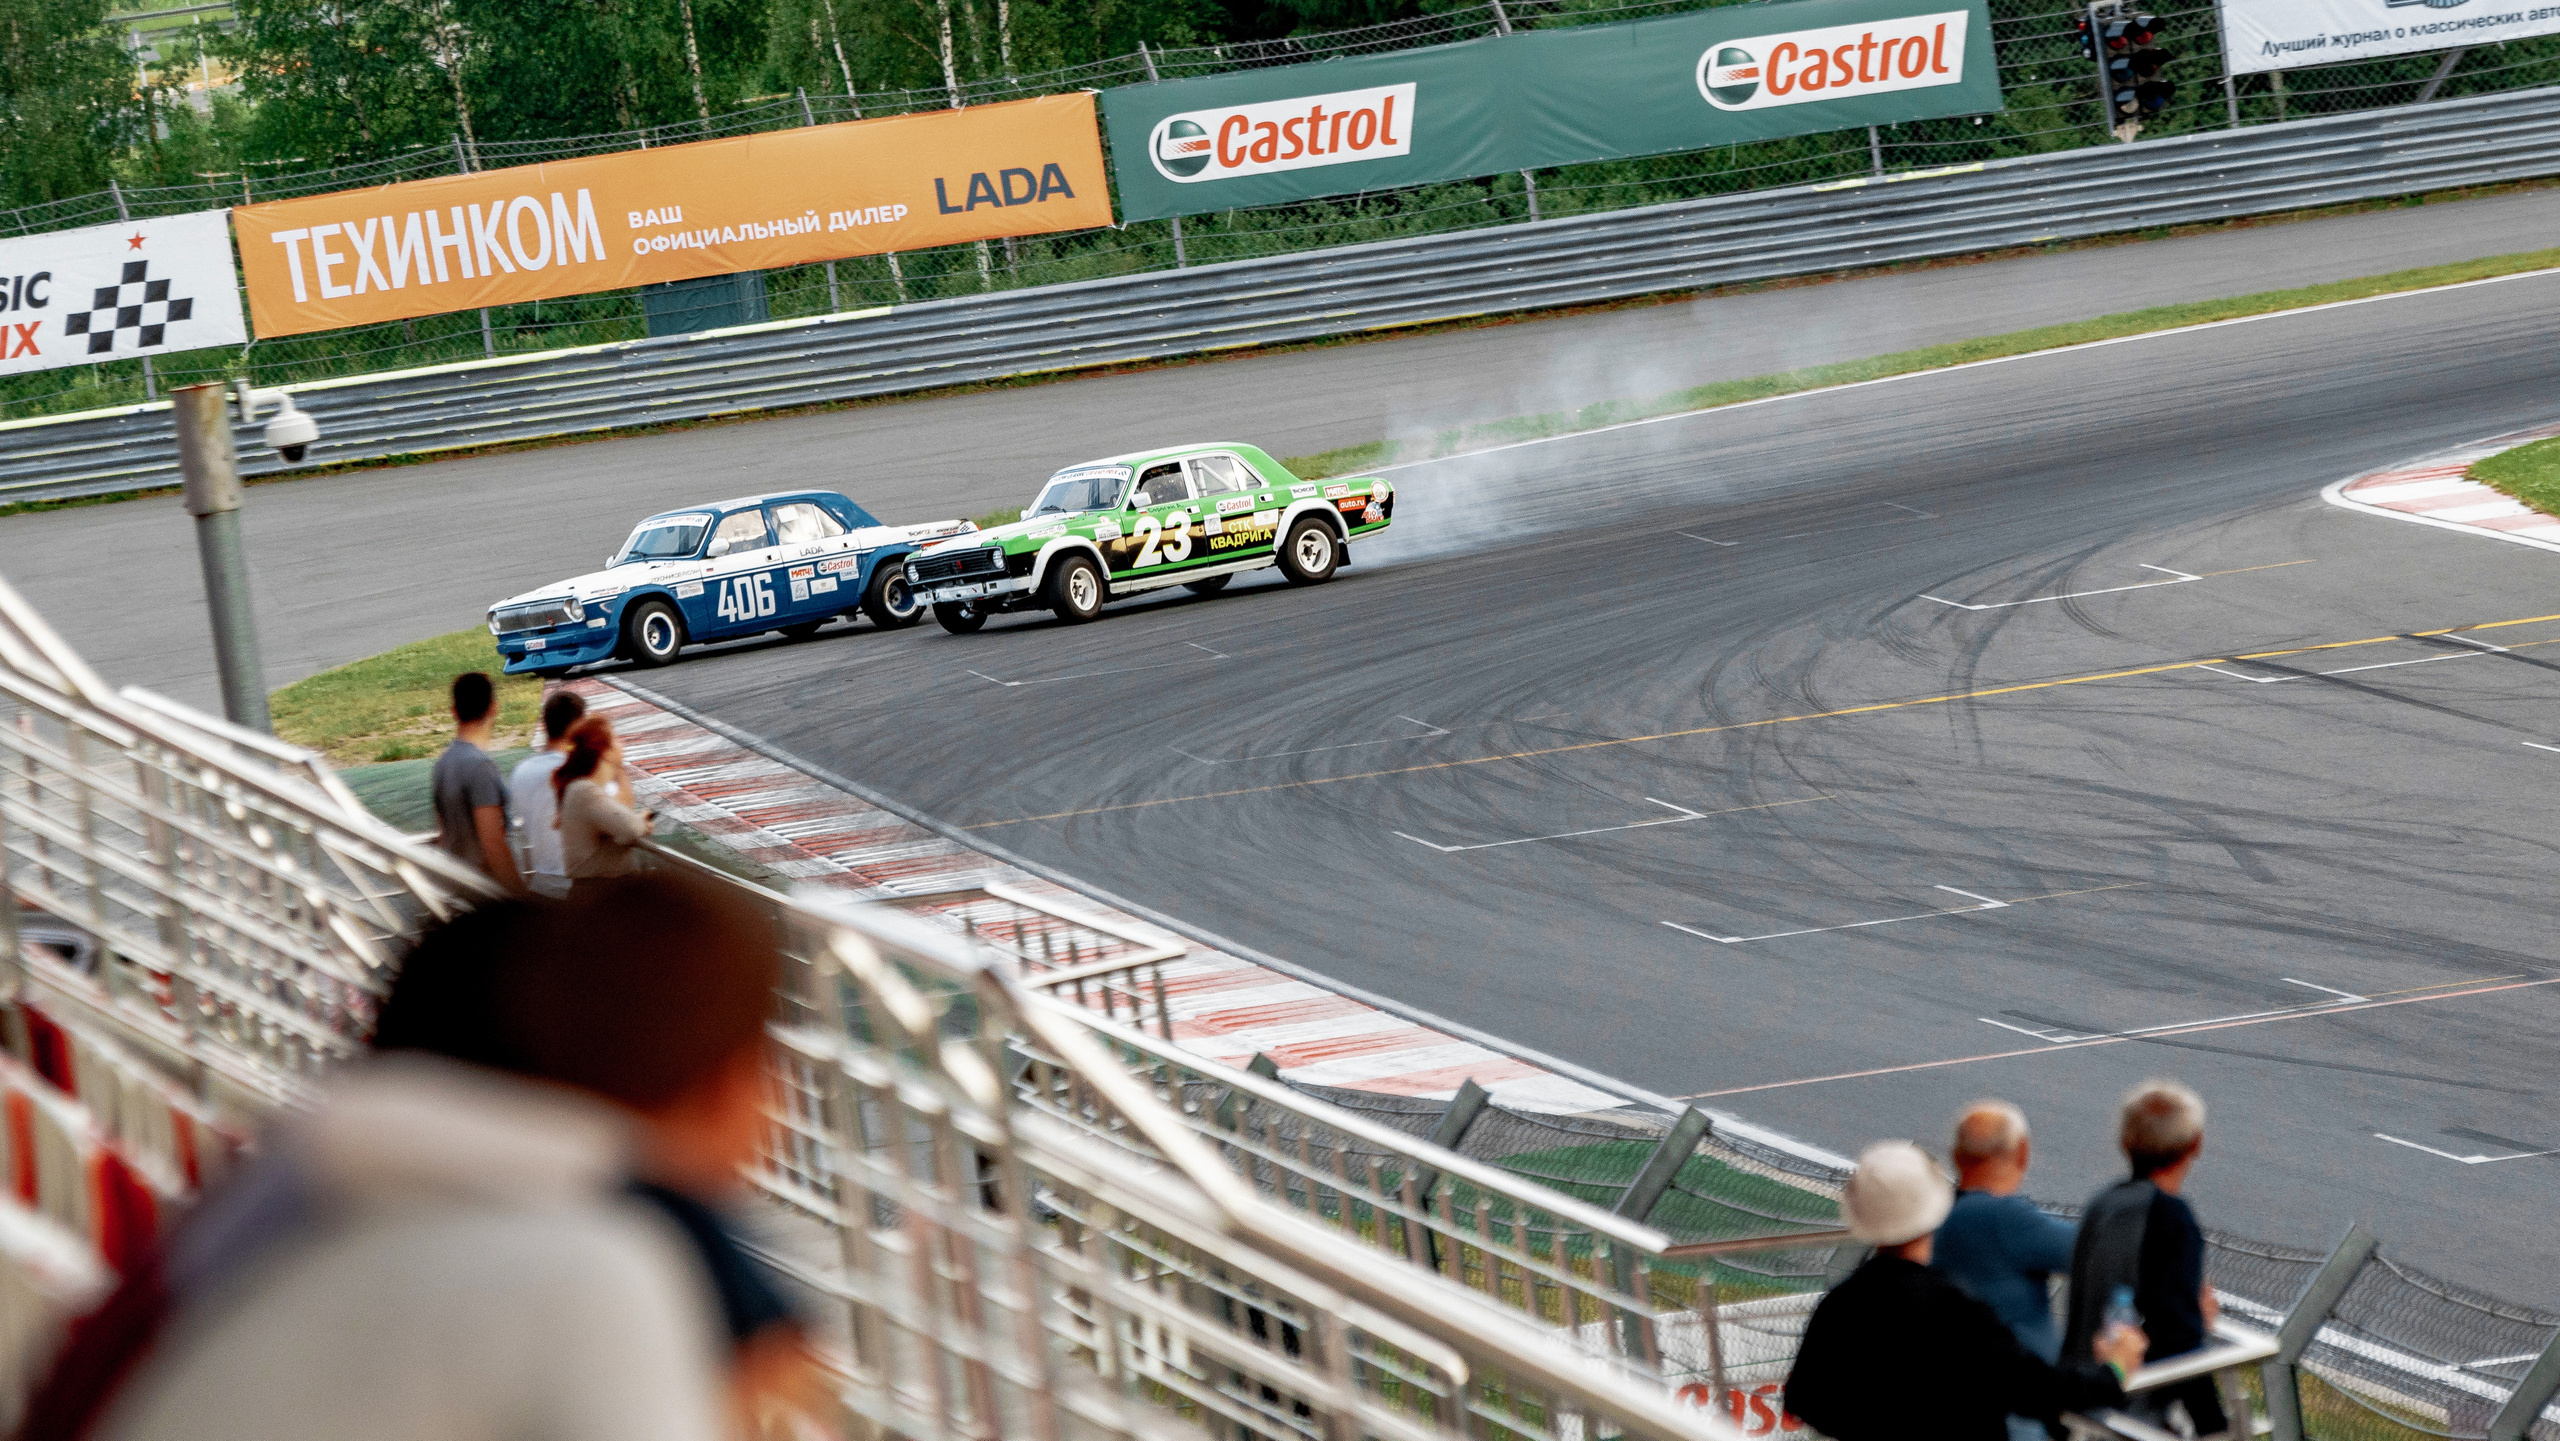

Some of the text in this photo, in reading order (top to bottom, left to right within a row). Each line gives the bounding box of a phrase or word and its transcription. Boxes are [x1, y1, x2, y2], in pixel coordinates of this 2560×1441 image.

[2261, 33, 2326, 56] Лучший
[2329, 29, 2391, 53] журнал
[2395, 27, 2405, 38] о
[2410, 11, 2524, 36] классических
[1766, 22, 1950, 96] Castrol
[1216, 95, 1399, 170] Castrol
[934, 163, 1075, 215] LADA
[628, 205, 683, 229] ВАШ
[633, 204, 908, 256] ОФИЦИАЛЬНЫЙ ДИЛЕР
[271, 188, 606, 303] ТЕХИНКОМ
[1226, 499, 1252, 511] Castrol
[1340, 499, 1365, 508] auto.ru
[1132, 510, 1192, 569] 23
[1210, 528, 1273, 550] КВАДРИГА
[1228, 519, 1252, 534] СТК
[800, 546, 824, 556] LADA
[827, 558, 853, 571] Castrol
[717, 573, 776, 623] 406
